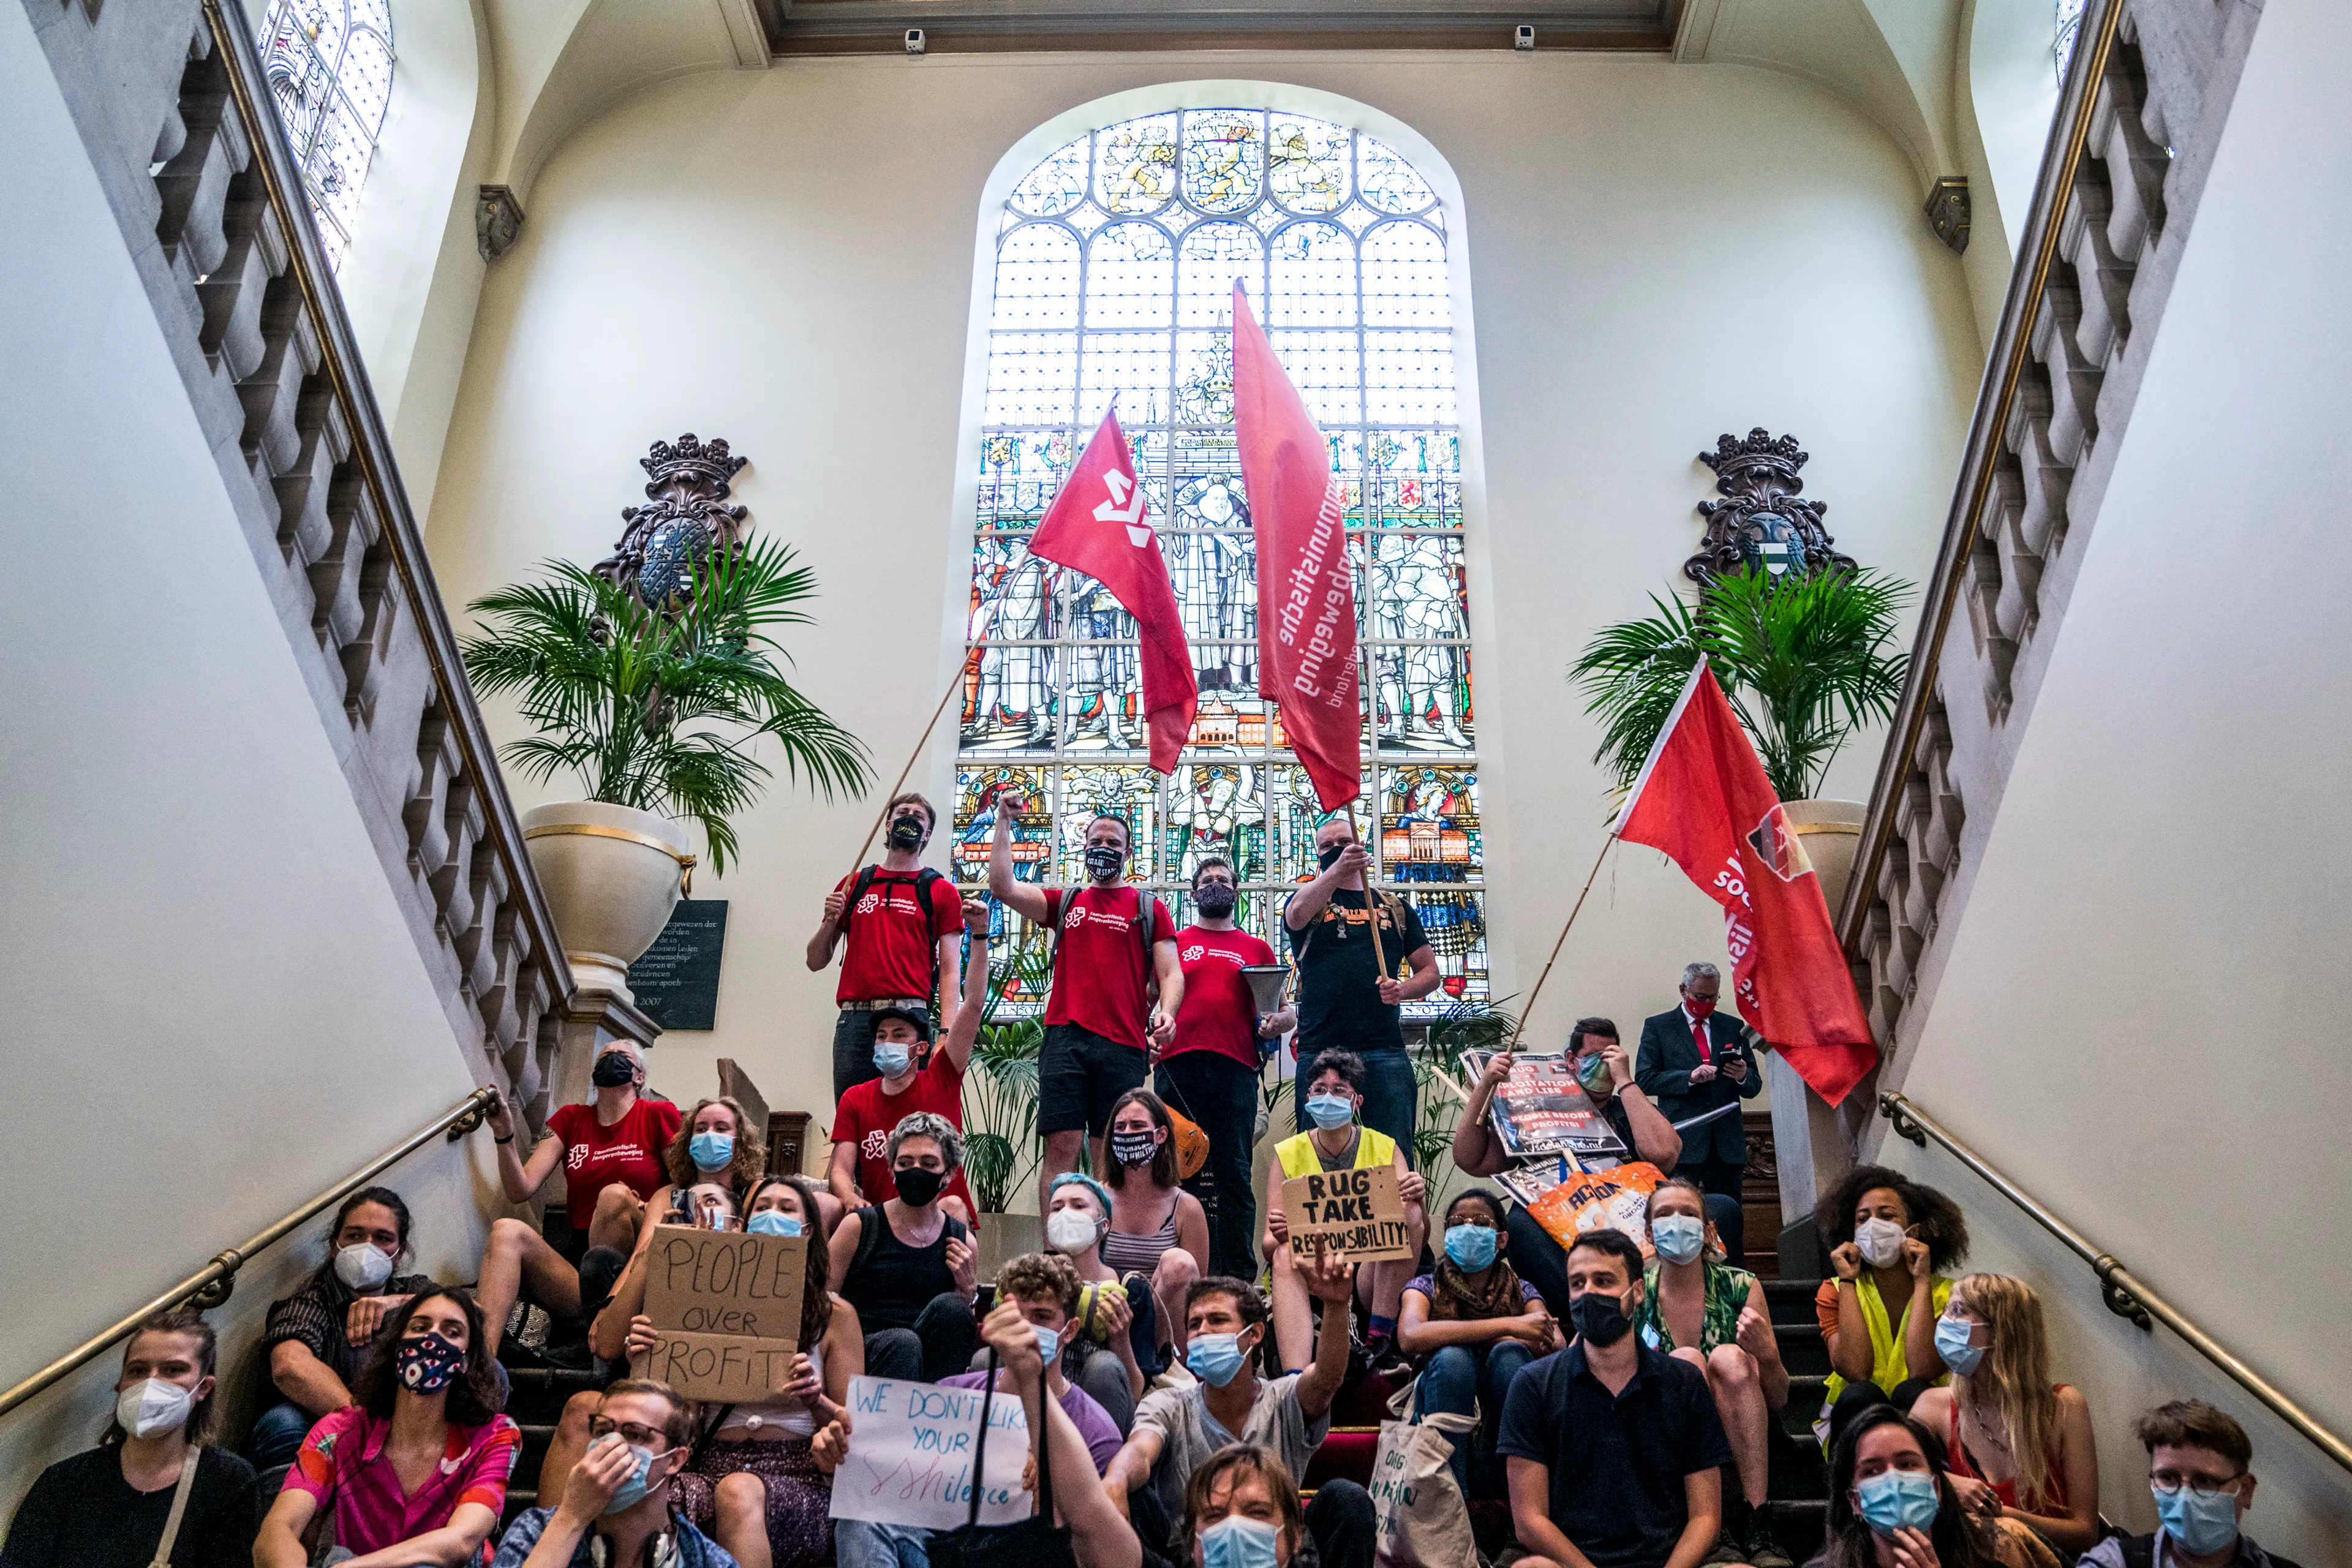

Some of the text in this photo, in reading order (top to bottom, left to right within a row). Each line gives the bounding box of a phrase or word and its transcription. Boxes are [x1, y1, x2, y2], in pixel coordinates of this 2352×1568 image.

[1088, 916, 1130, 929] jongerenbeweging
[1090, 911, 1126, 921] communistische
[1207, 951, 1246, 965] jongerenbeweging
[1208, 948, 1242, 958] communistische
[1499, 1079, 1578, 1089] XPLOITATION
[1507, 1088, 1534, 1096] AND
[1510, 1112, 1551, 1121] PEOPLE
[1531, 1120, 1581, 1128] PROFITS!
[592, 1149, 644, 1162] jongerenbeweging
[594, 1143, 638, 1155] communistische
[1302, 1195, 1375, 1224] TAKE
[1622, 1199, 1646, 1220] GROOT
[1291, 1221, 1410, 1254] RESPONSIBILITY!
[664, 1237, 798, 1299] PEOPLE
[856, 1380, 894, 1414] WE
[908, 1388, 983, 1422] DON'T
[913, 1426, 970, 1455] YOUR
